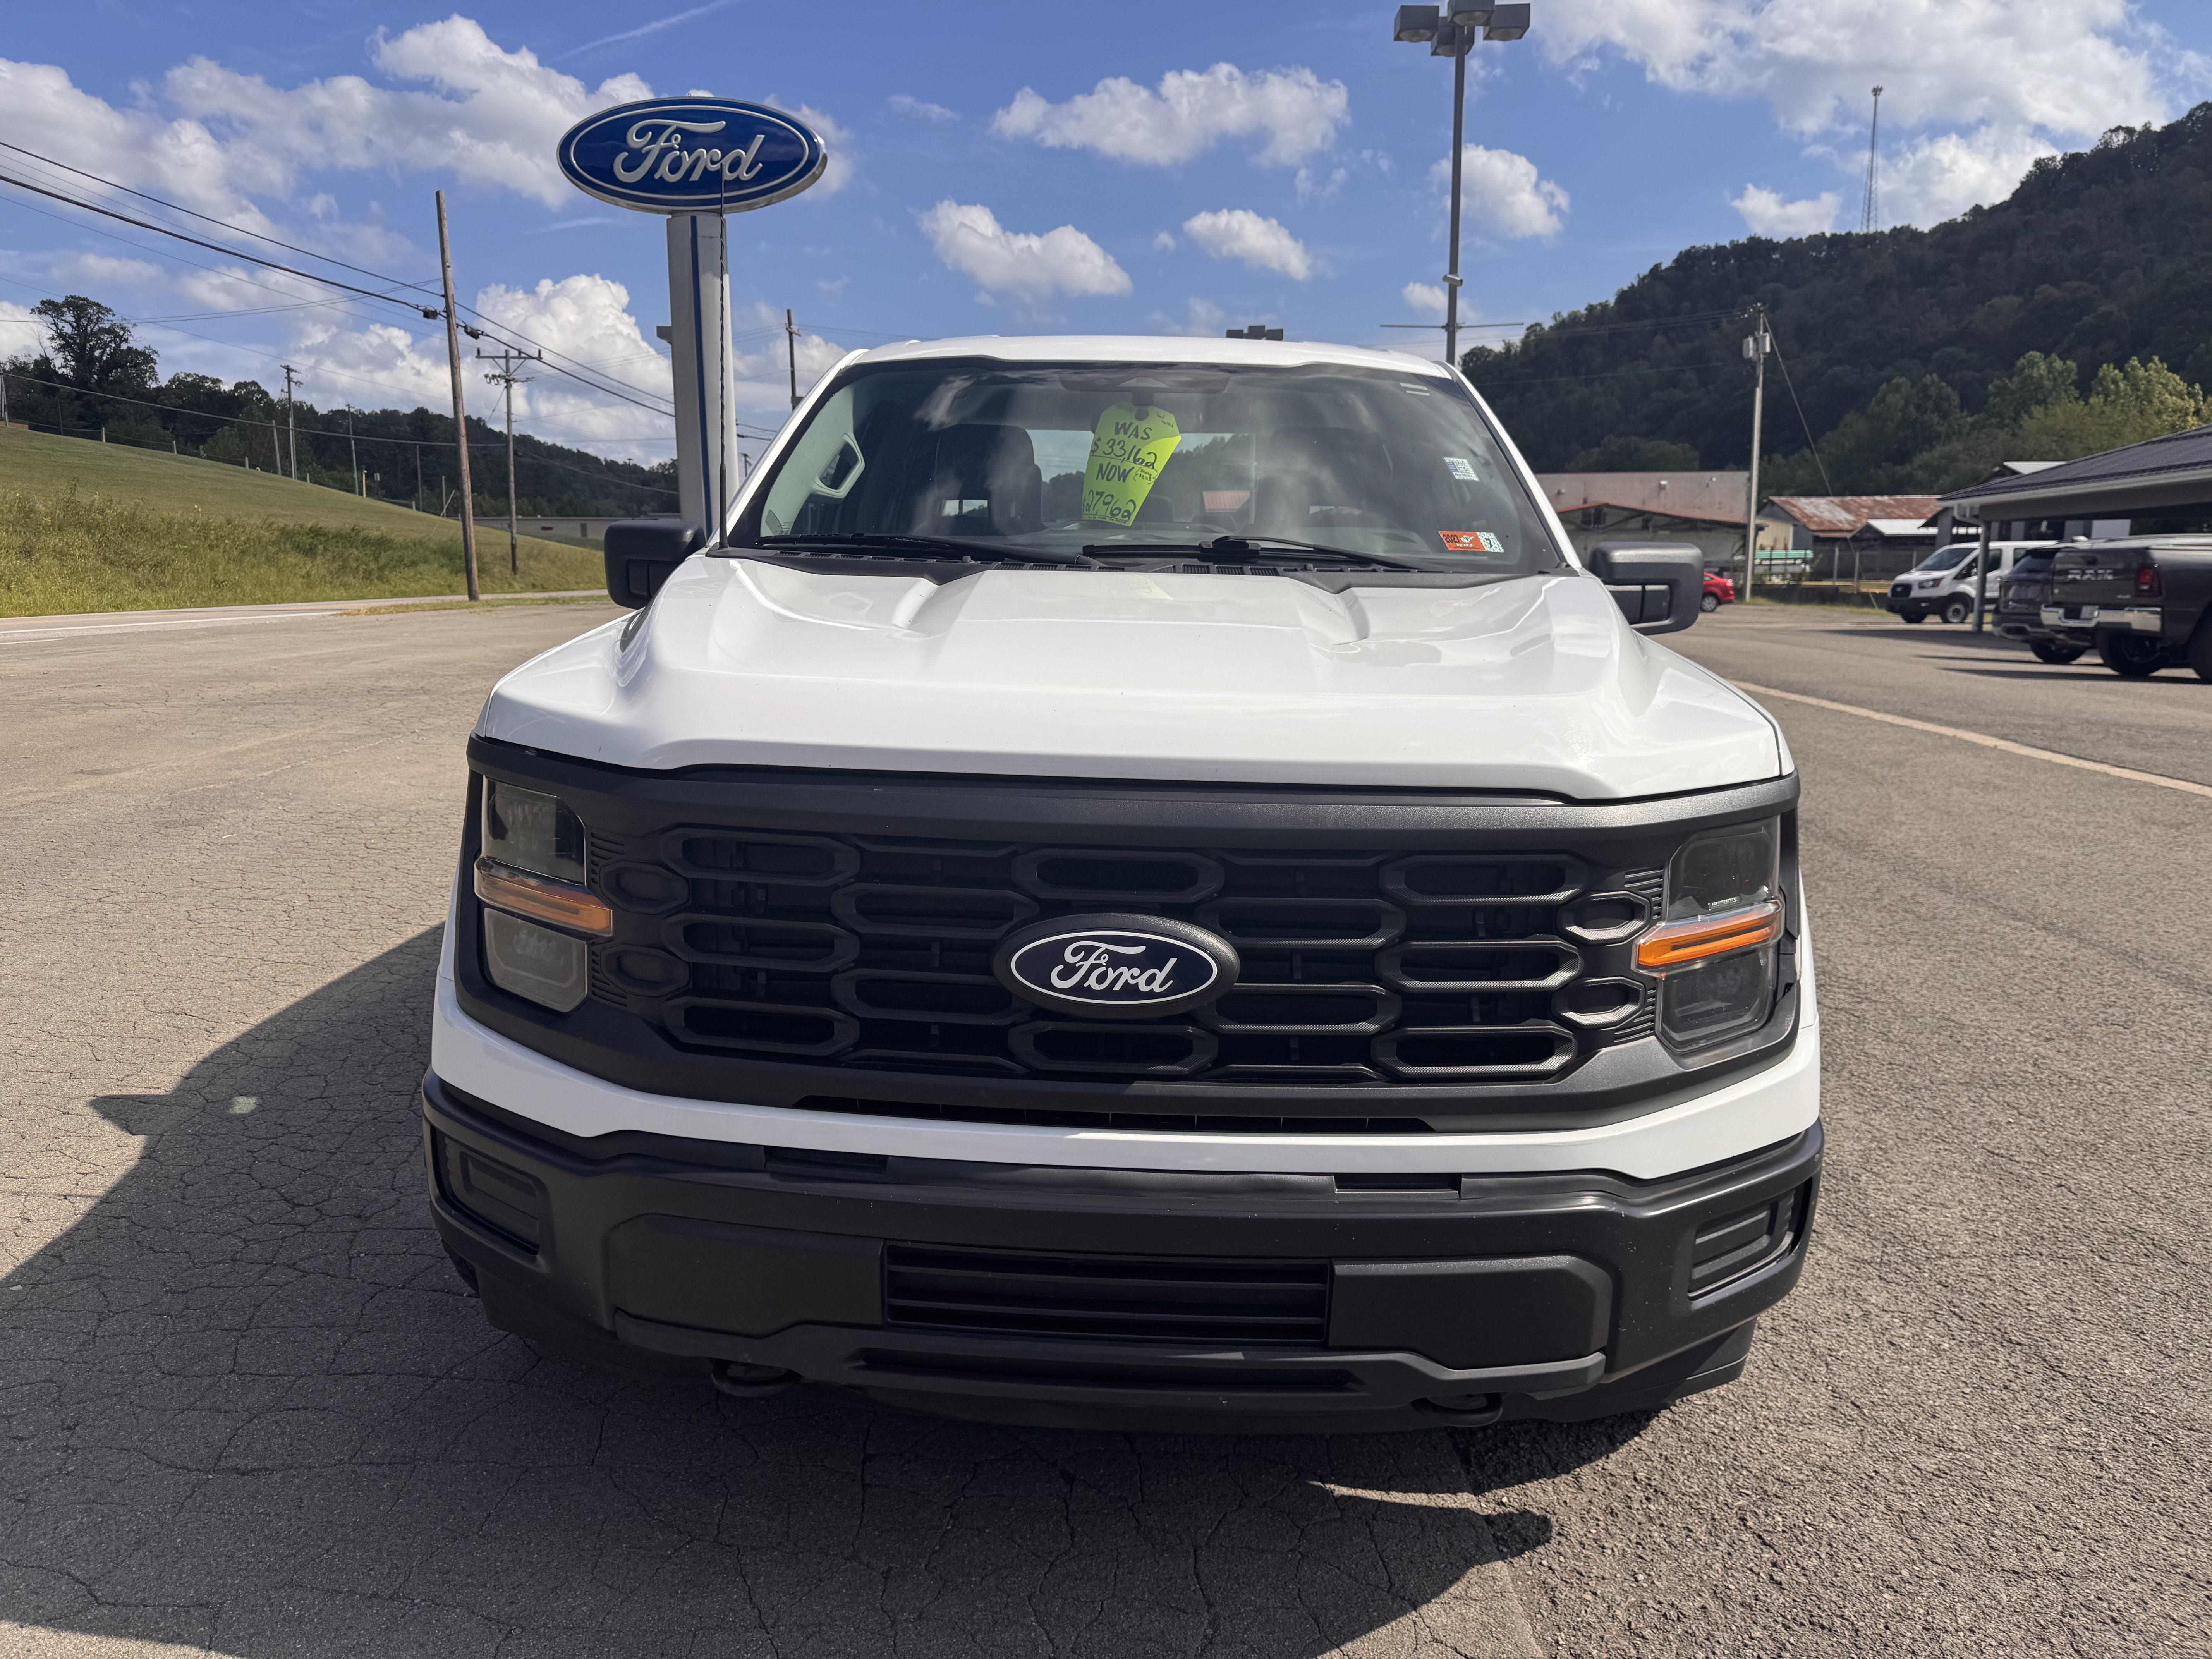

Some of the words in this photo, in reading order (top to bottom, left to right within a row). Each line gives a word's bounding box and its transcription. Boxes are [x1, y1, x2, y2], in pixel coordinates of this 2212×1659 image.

[613, 118, 765, 183] Ford
[1114, 422, 1152, 440] WAS
[1096, 461, 1135, 483] NOW
[1443, 534, 1460, 544] 2027
[1484, 538, 1493, 548] 7
[1050, 941, 1178, 993] Ford
